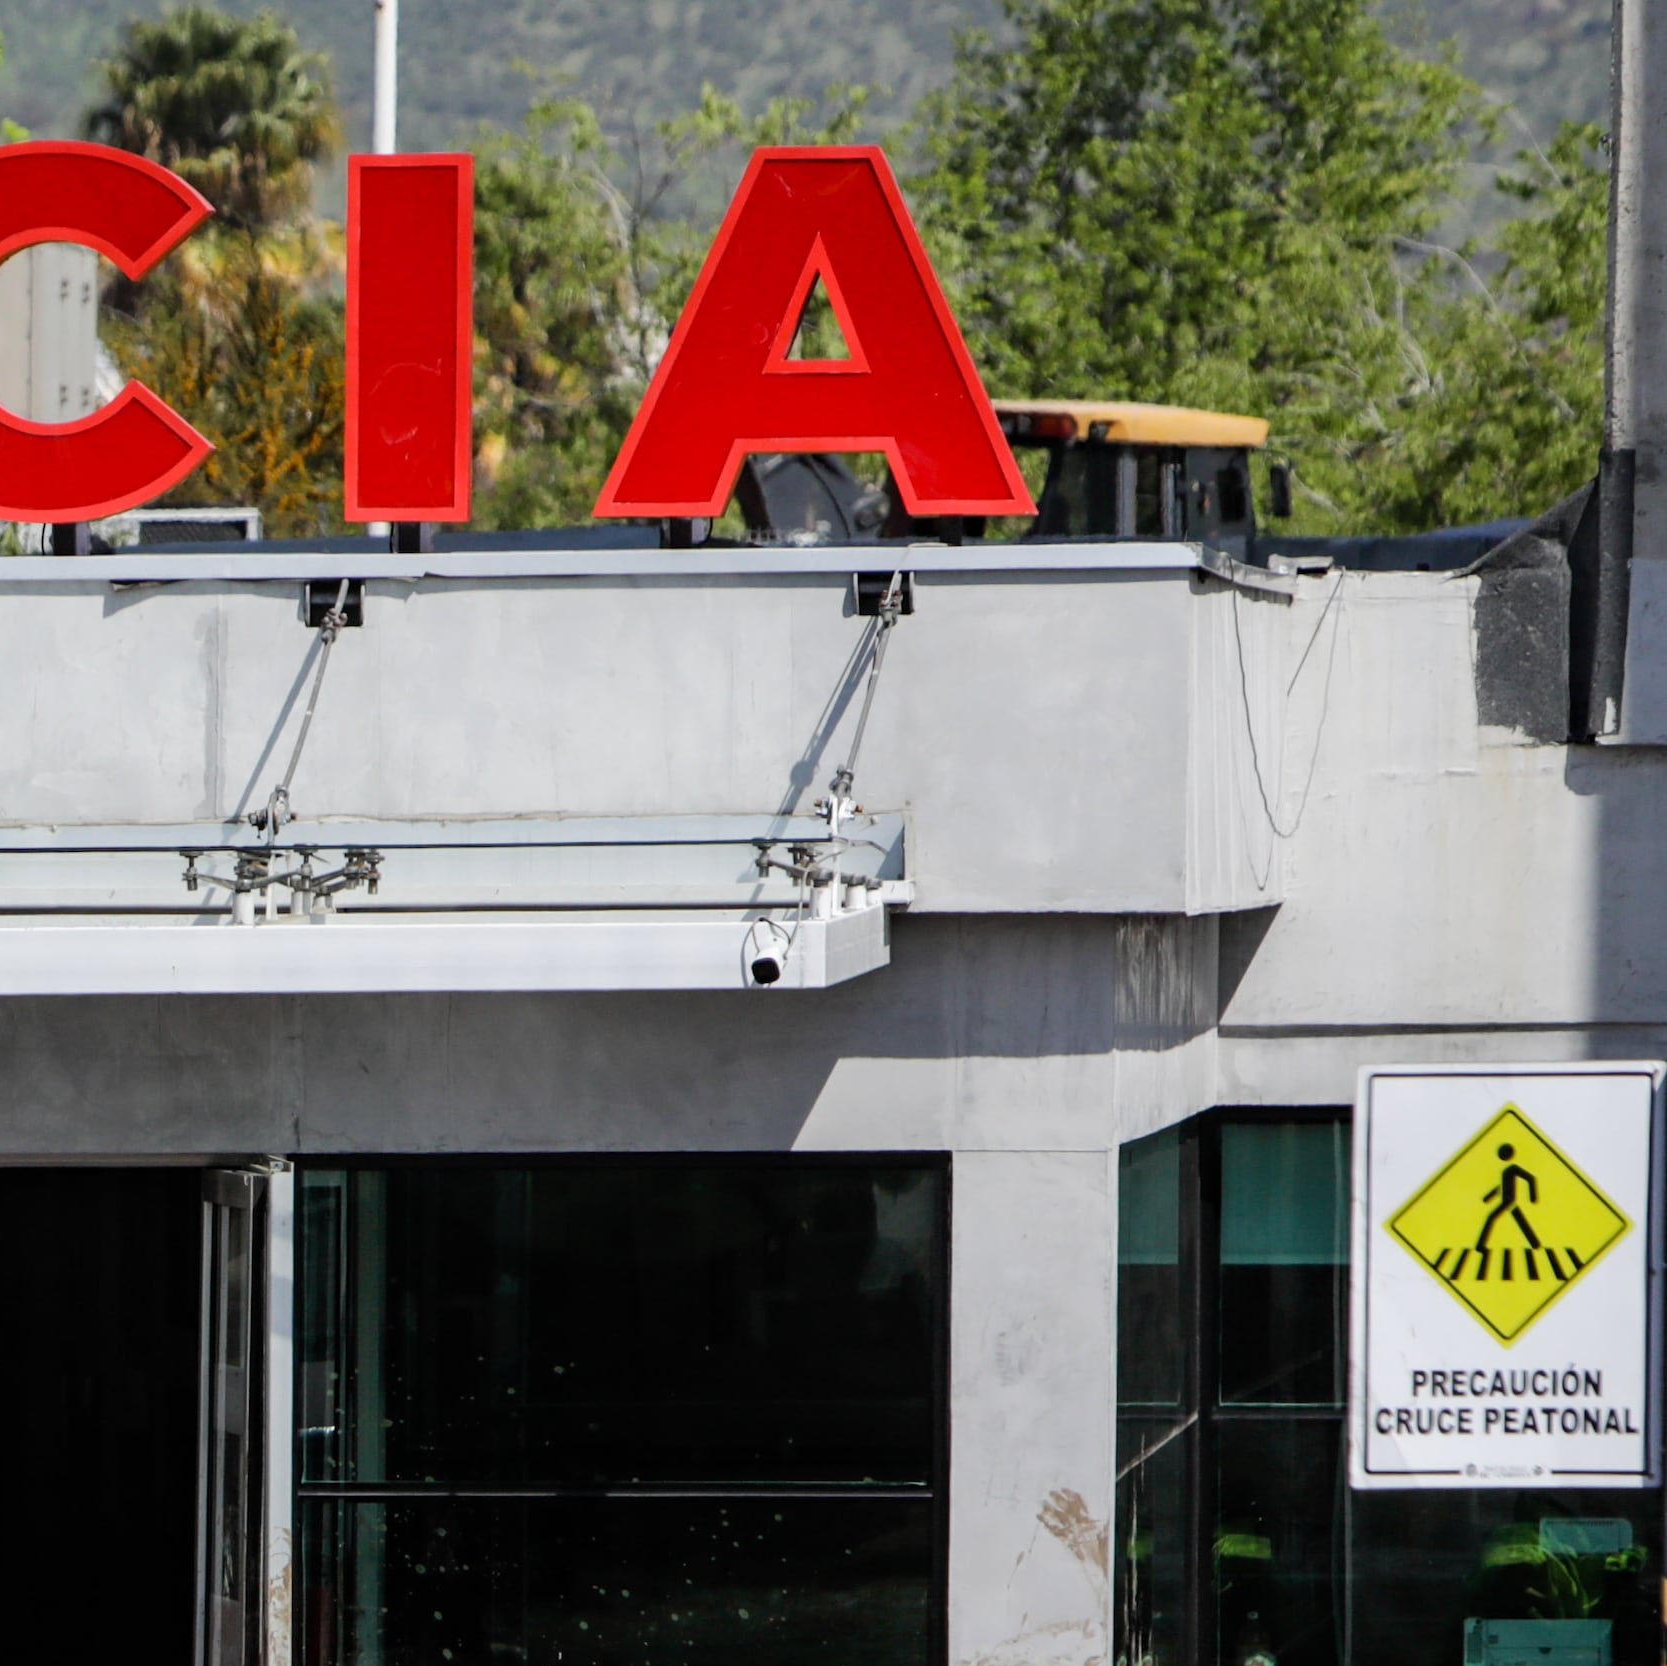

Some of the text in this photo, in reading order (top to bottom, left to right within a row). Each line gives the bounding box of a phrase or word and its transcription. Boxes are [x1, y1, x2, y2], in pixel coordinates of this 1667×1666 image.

[1411, 1362, 1603, 1397] PRECAUCIÓN
[1375, 1407, 1640, 1435] CRUCE PEATONAL
